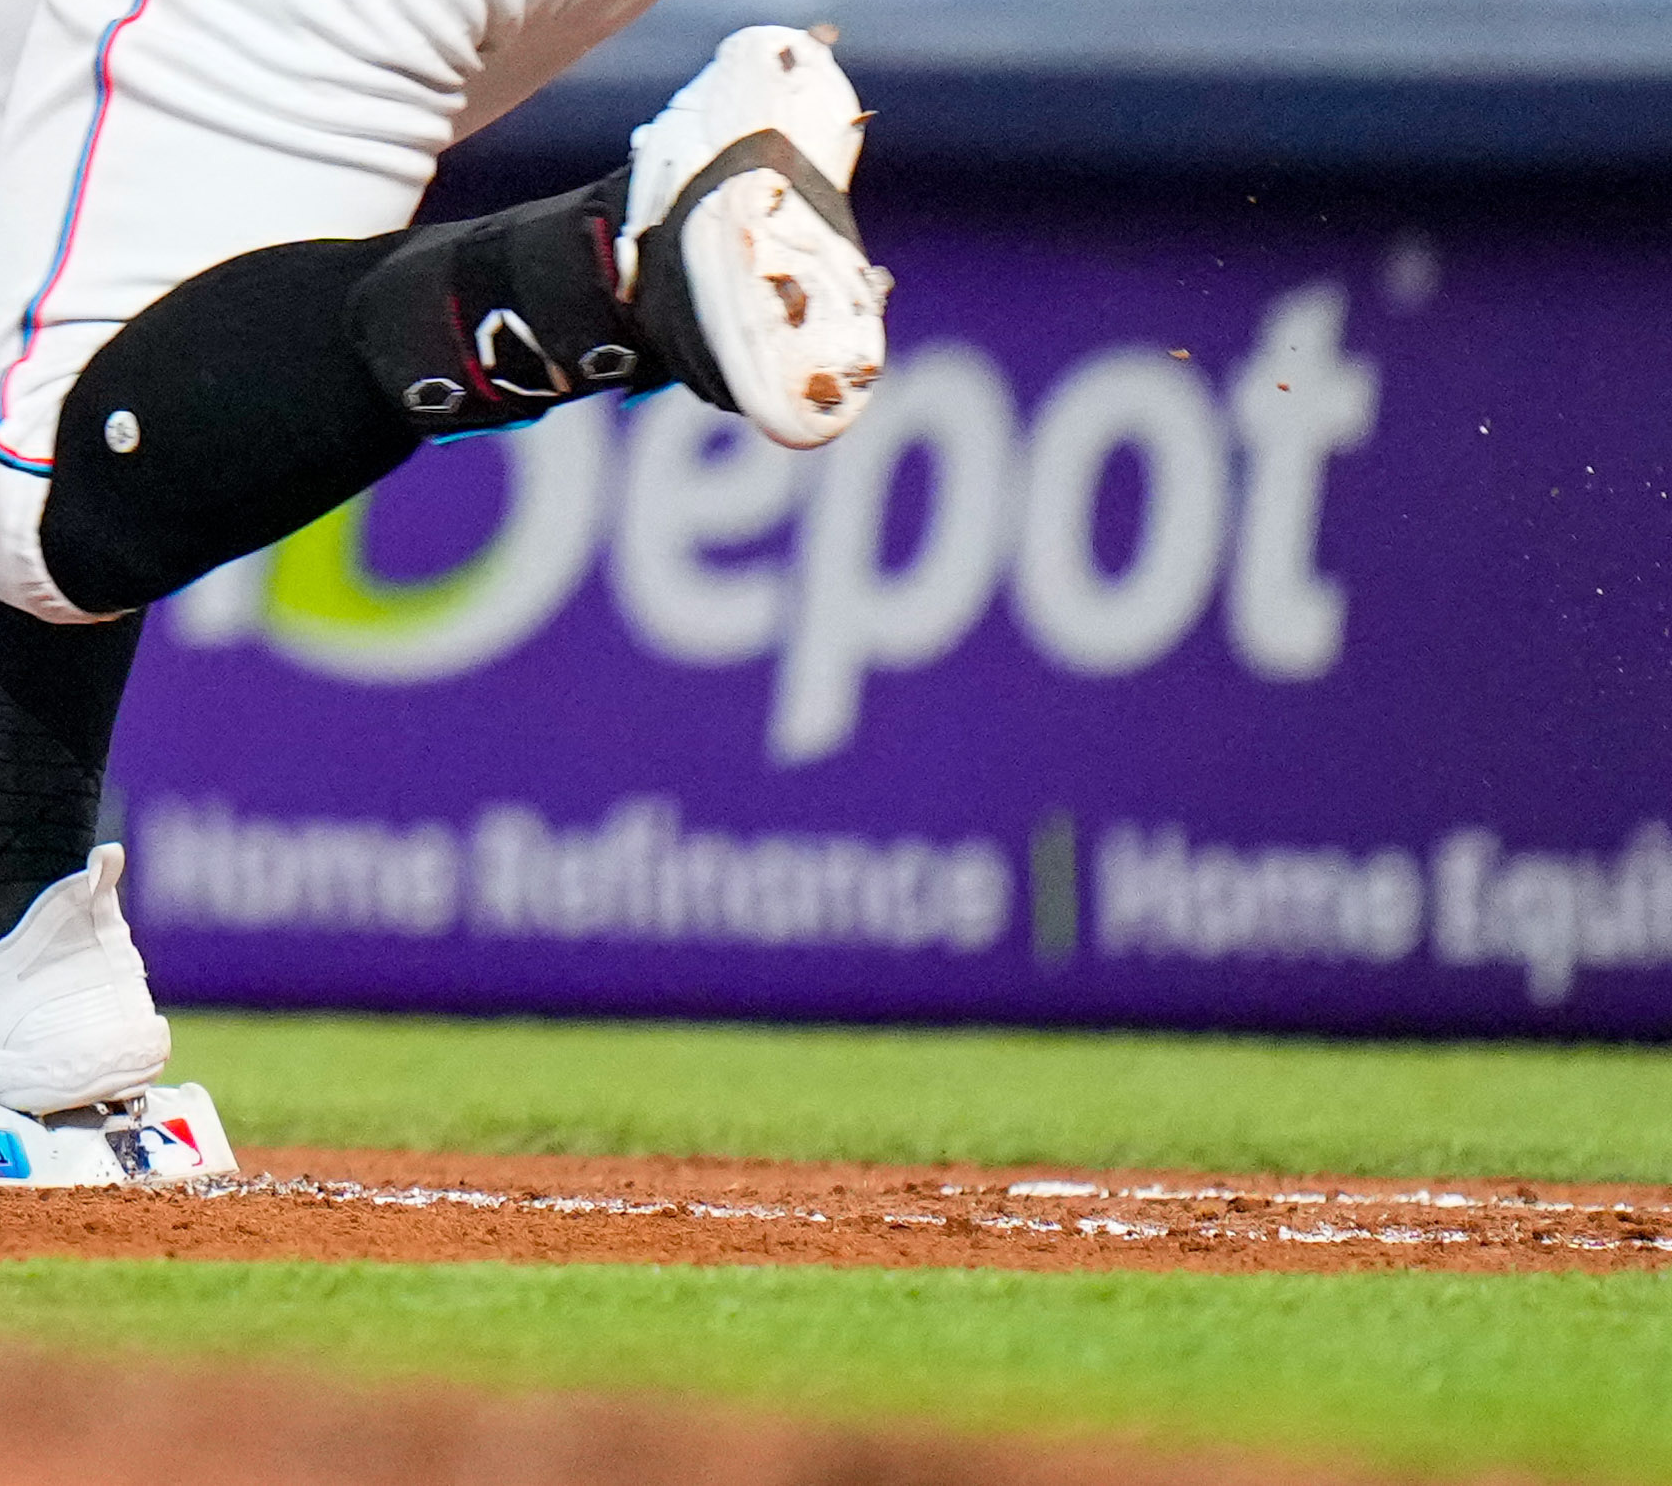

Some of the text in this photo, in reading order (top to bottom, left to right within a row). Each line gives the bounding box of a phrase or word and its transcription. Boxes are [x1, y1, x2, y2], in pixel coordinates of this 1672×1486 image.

[139, 797, 458, 933] Home
[470, 794, 1010, 953] Refinance
[1095, 820, 1423, 965] Home
